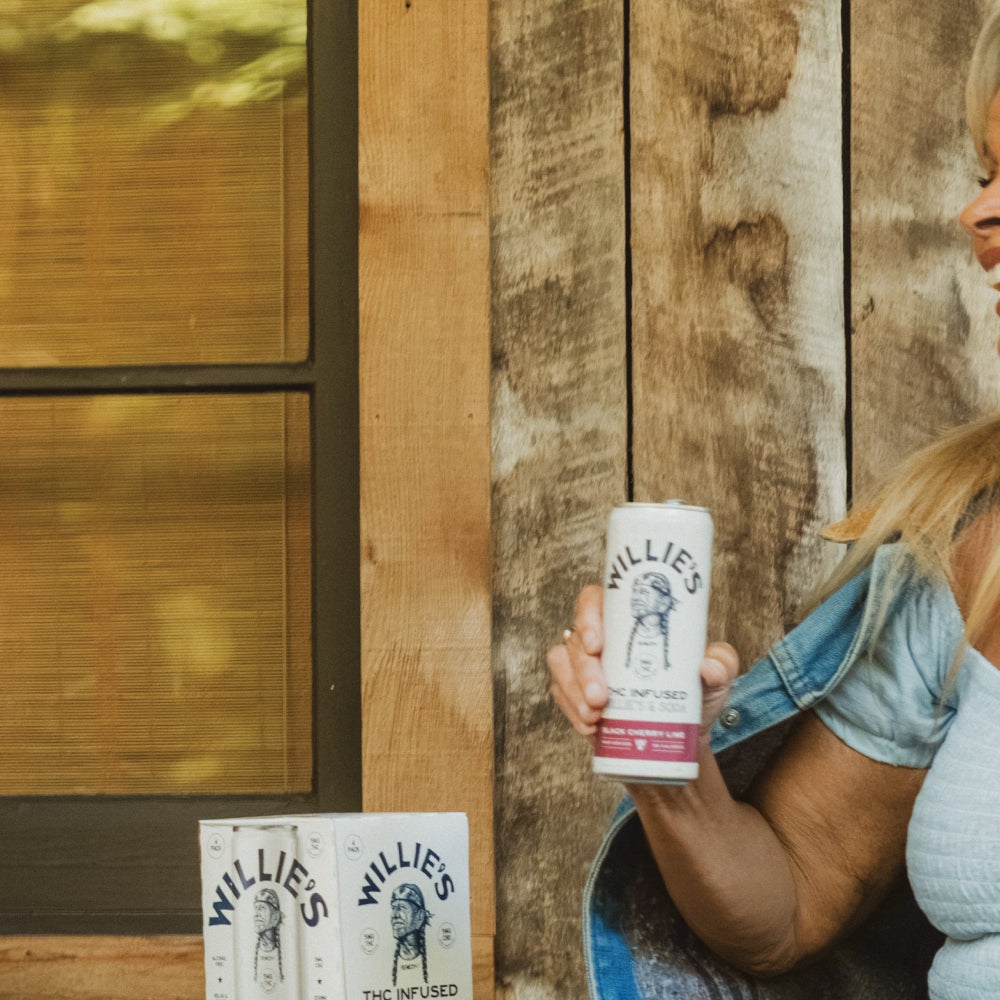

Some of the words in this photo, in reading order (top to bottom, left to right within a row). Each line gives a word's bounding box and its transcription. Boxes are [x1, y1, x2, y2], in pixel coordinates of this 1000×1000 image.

[607, 539, 703, 595] WILLIE'S
[630, 688, 689, 701] INFUSED
[208, 848, 329, 928] WILLIE'S
[357, 841, 455, 906] WILLIE'S
[396, 984, 459, 1000] INFUSED
